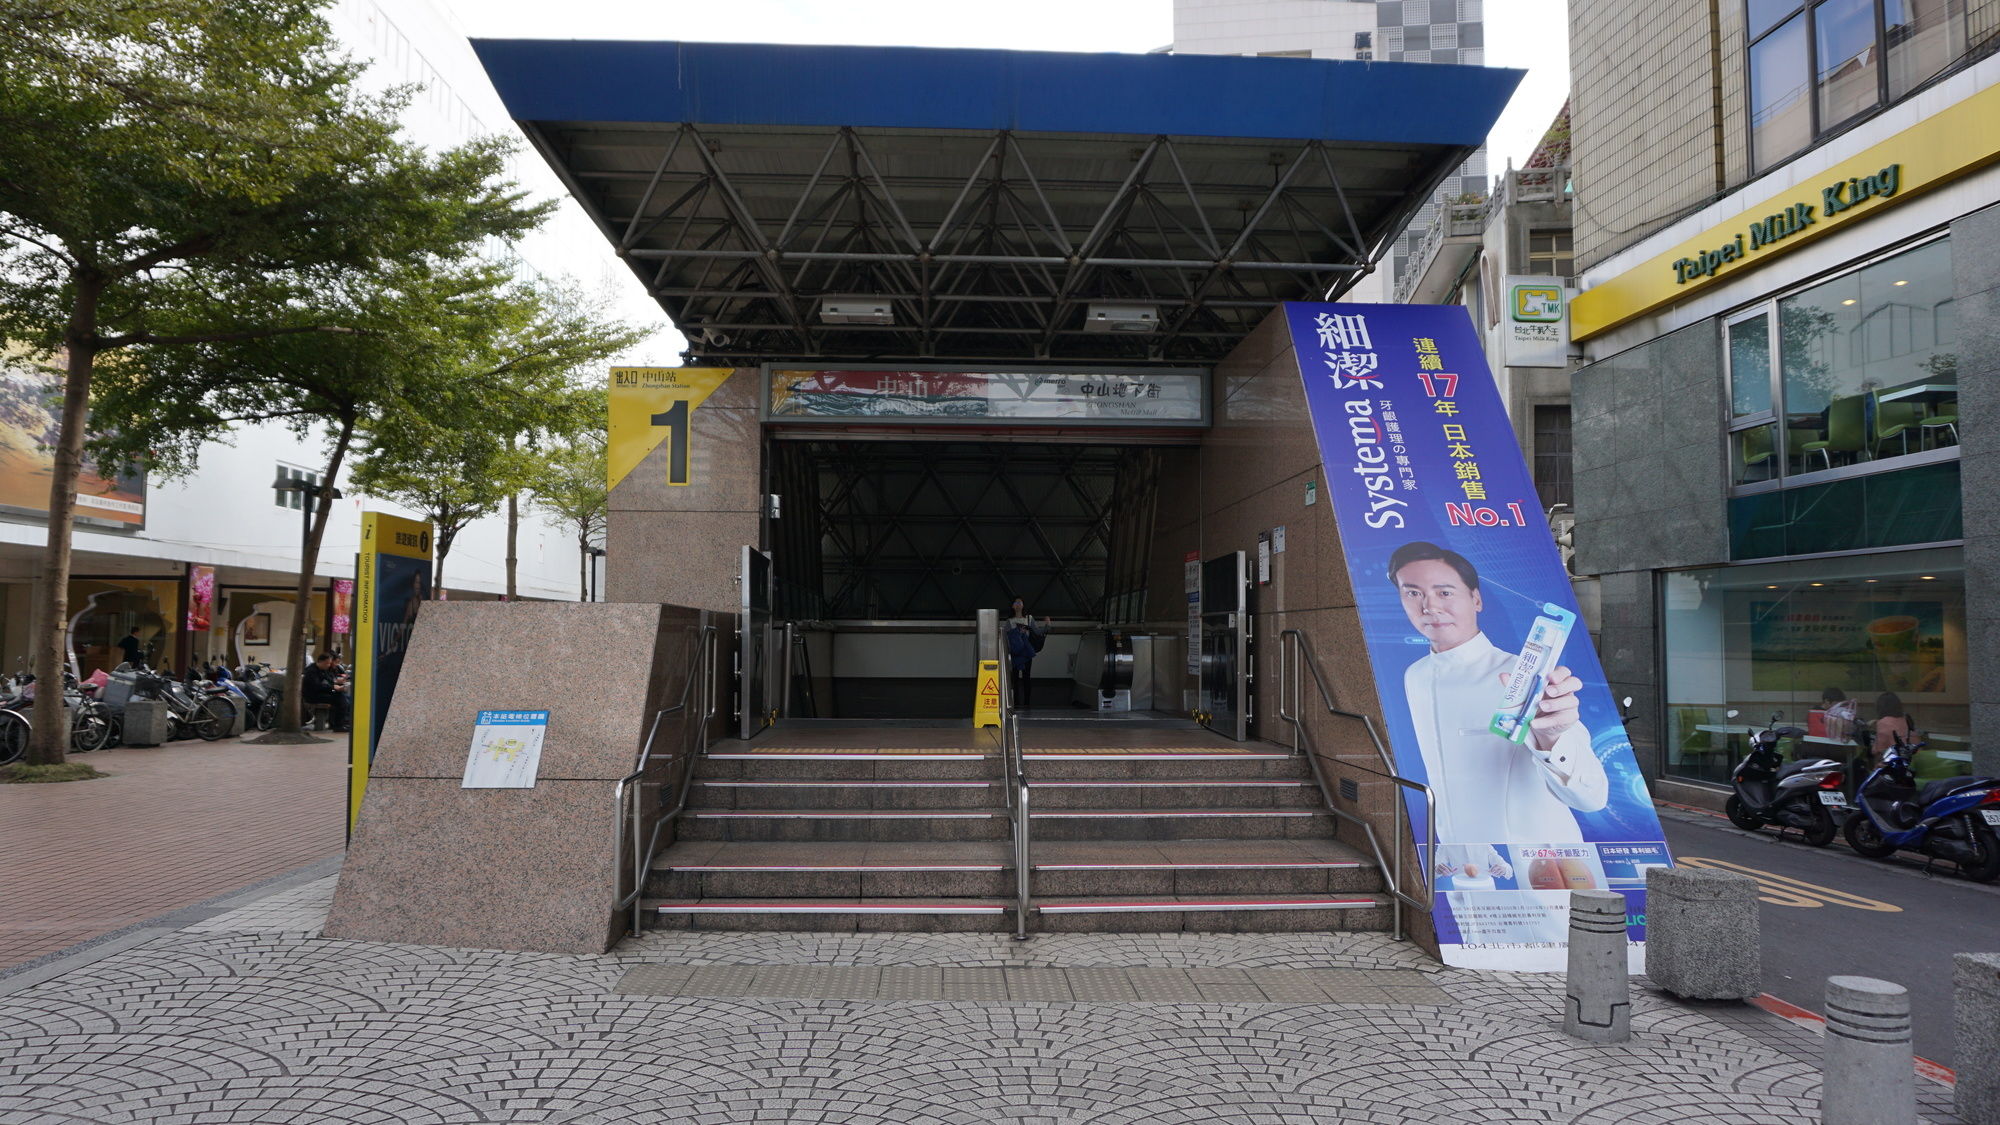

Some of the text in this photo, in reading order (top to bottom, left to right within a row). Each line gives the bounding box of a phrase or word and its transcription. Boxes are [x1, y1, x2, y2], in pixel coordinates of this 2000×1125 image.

[1672, 163, 1902, 285] Taipei Milk King
[1541, 302, 1560, 314] TMK
[1515, 325, 1559, 336] 台北牛乳大王
[1314, 312, 1384, 390] 細潔
[616, 371, 677, 384] 出入口 中山站
[876, 376, 929, 398] 中山
[1080, 382, 1161, 399] 中山地下街
[651, 401, 688, 483] 1
[1344, 399, 1408, 529] Systema
[1445, 502, 1526, 527] No.1
[1506, 673, 1525, 702] Systema
